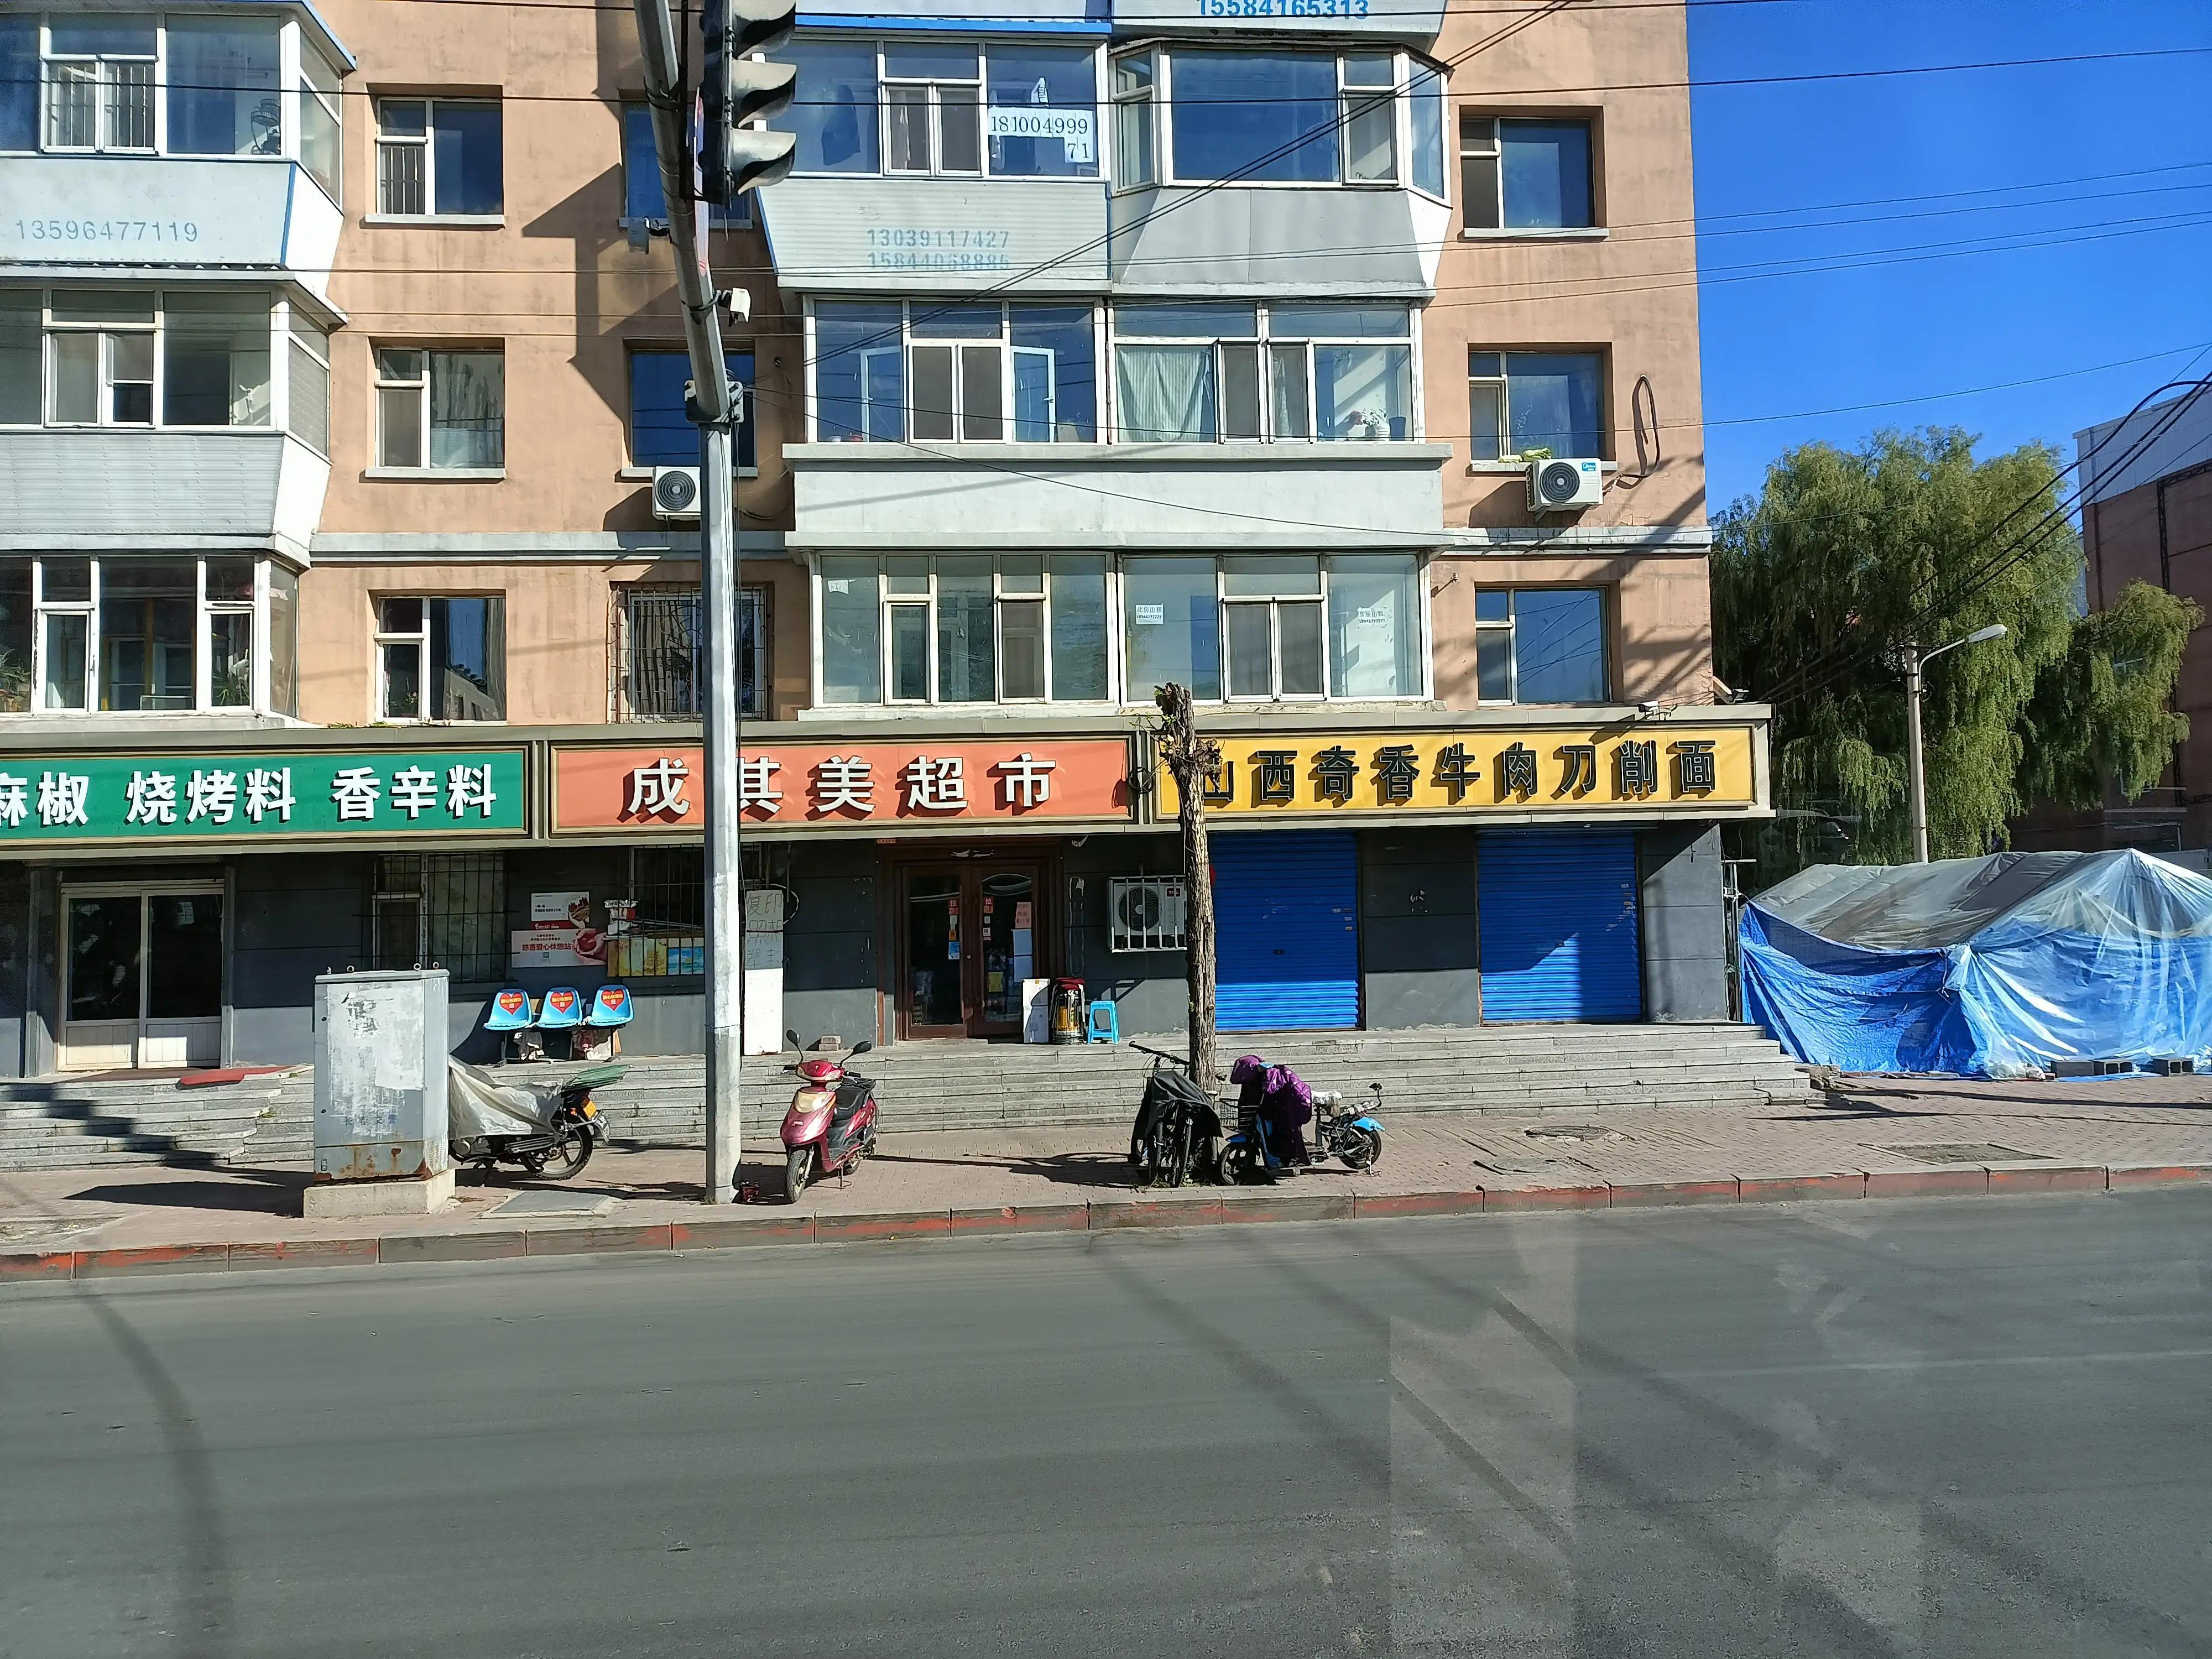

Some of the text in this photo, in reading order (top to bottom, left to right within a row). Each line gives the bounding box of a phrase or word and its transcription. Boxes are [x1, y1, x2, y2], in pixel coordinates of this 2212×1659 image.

[991, 116, 1088, 134] 181004999
[1067, 143, 1089, 159] 71
[15, 219, 197, 242] 13596477119
[867, 228, 1009, 248] 13039117427
[126, 768, 296, 824] 烧烤料
[332, 764, 497, 821] 香辛料
[628, 753, 1057, 815] 成其美超市
[747, 893, 783, 916] 复印
